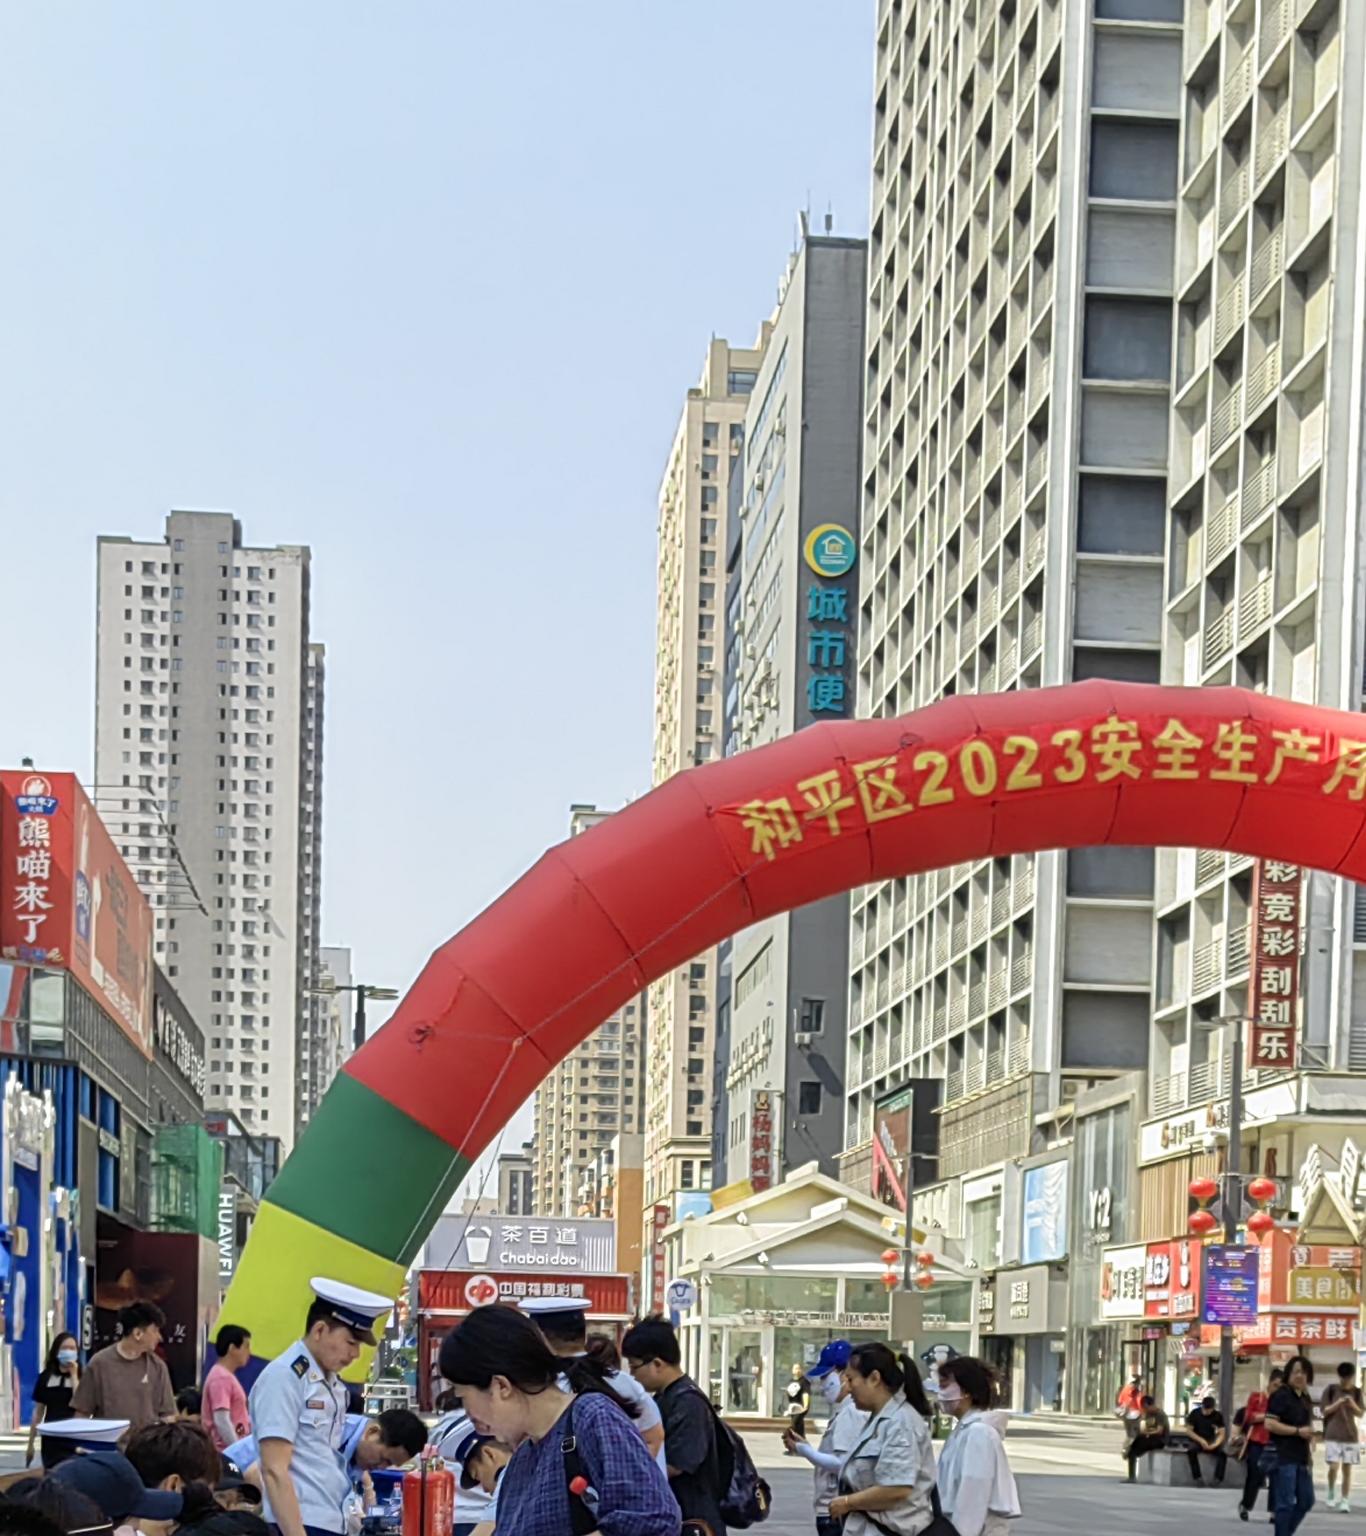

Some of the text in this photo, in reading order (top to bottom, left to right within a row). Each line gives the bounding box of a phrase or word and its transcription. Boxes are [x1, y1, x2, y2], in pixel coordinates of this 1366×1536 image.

[501, 1225, 578, 1245] 茶百道
[499, 1281, 585, 1297] 中国福利彩票
